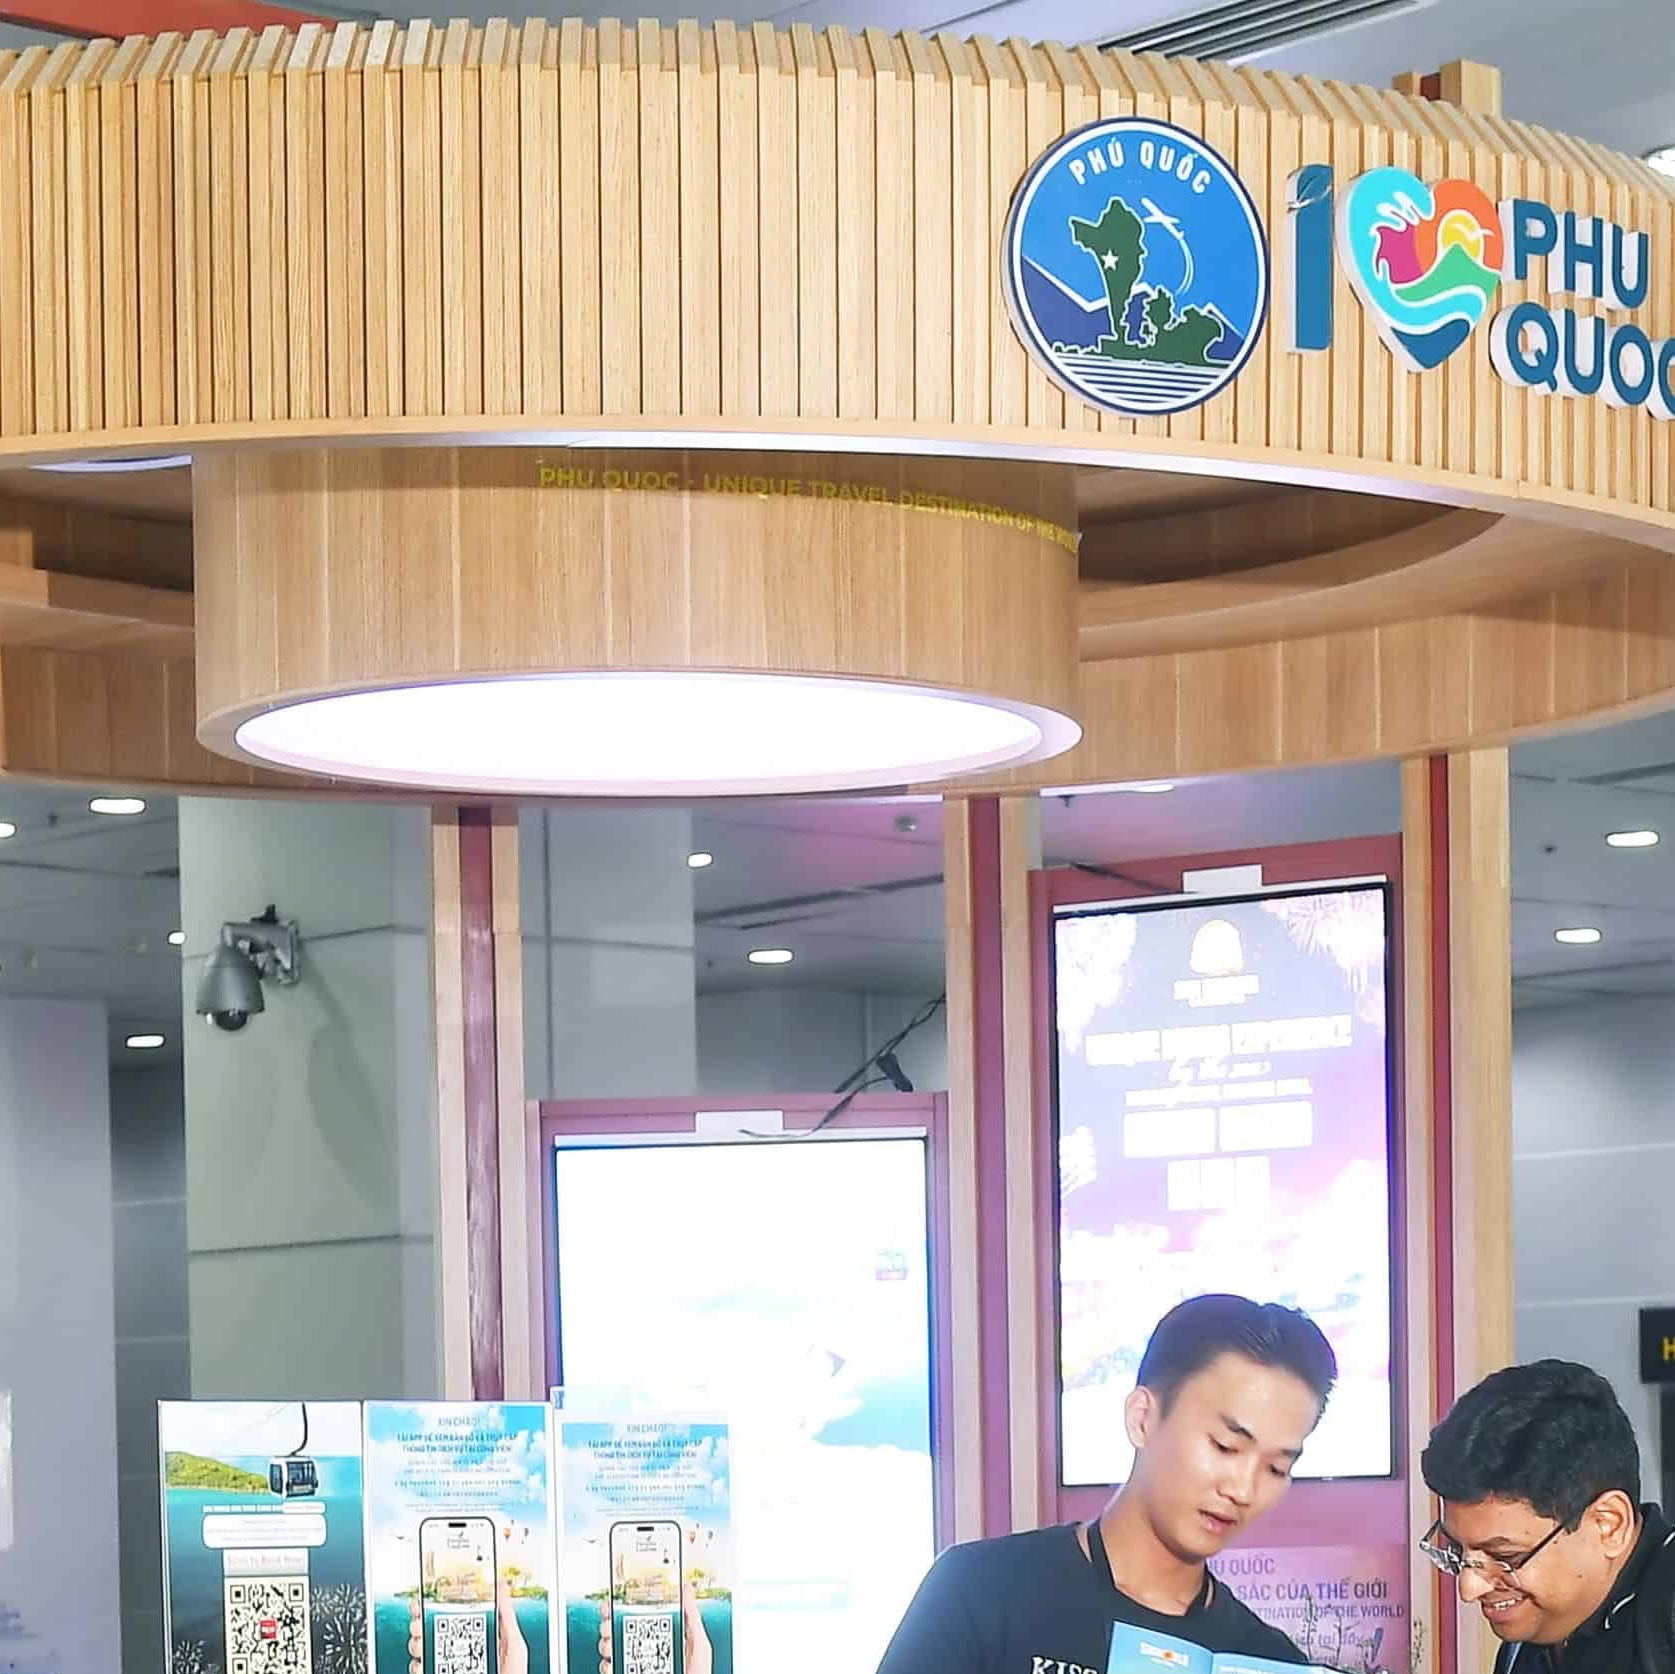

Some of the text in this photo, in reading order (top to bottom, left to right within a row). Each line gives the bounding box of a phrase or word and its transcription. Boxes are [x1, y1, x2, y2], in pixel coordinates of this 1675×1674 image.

[1068, 136, 1212, 194] PHÚ QUỐC
[1504, 199, 1650, 312] PHU
[603, 469, 680, 493] QUOC
[704, 473, 803, 498] UNIQUE
[809, 480, 894, 506] TRAVEL
[1230, 1551, 1276, 1575] QUỐC
[1255, 1606, 1308, 1619] TINATIO
[1359, 1604, 1405, 1618] WORLD
